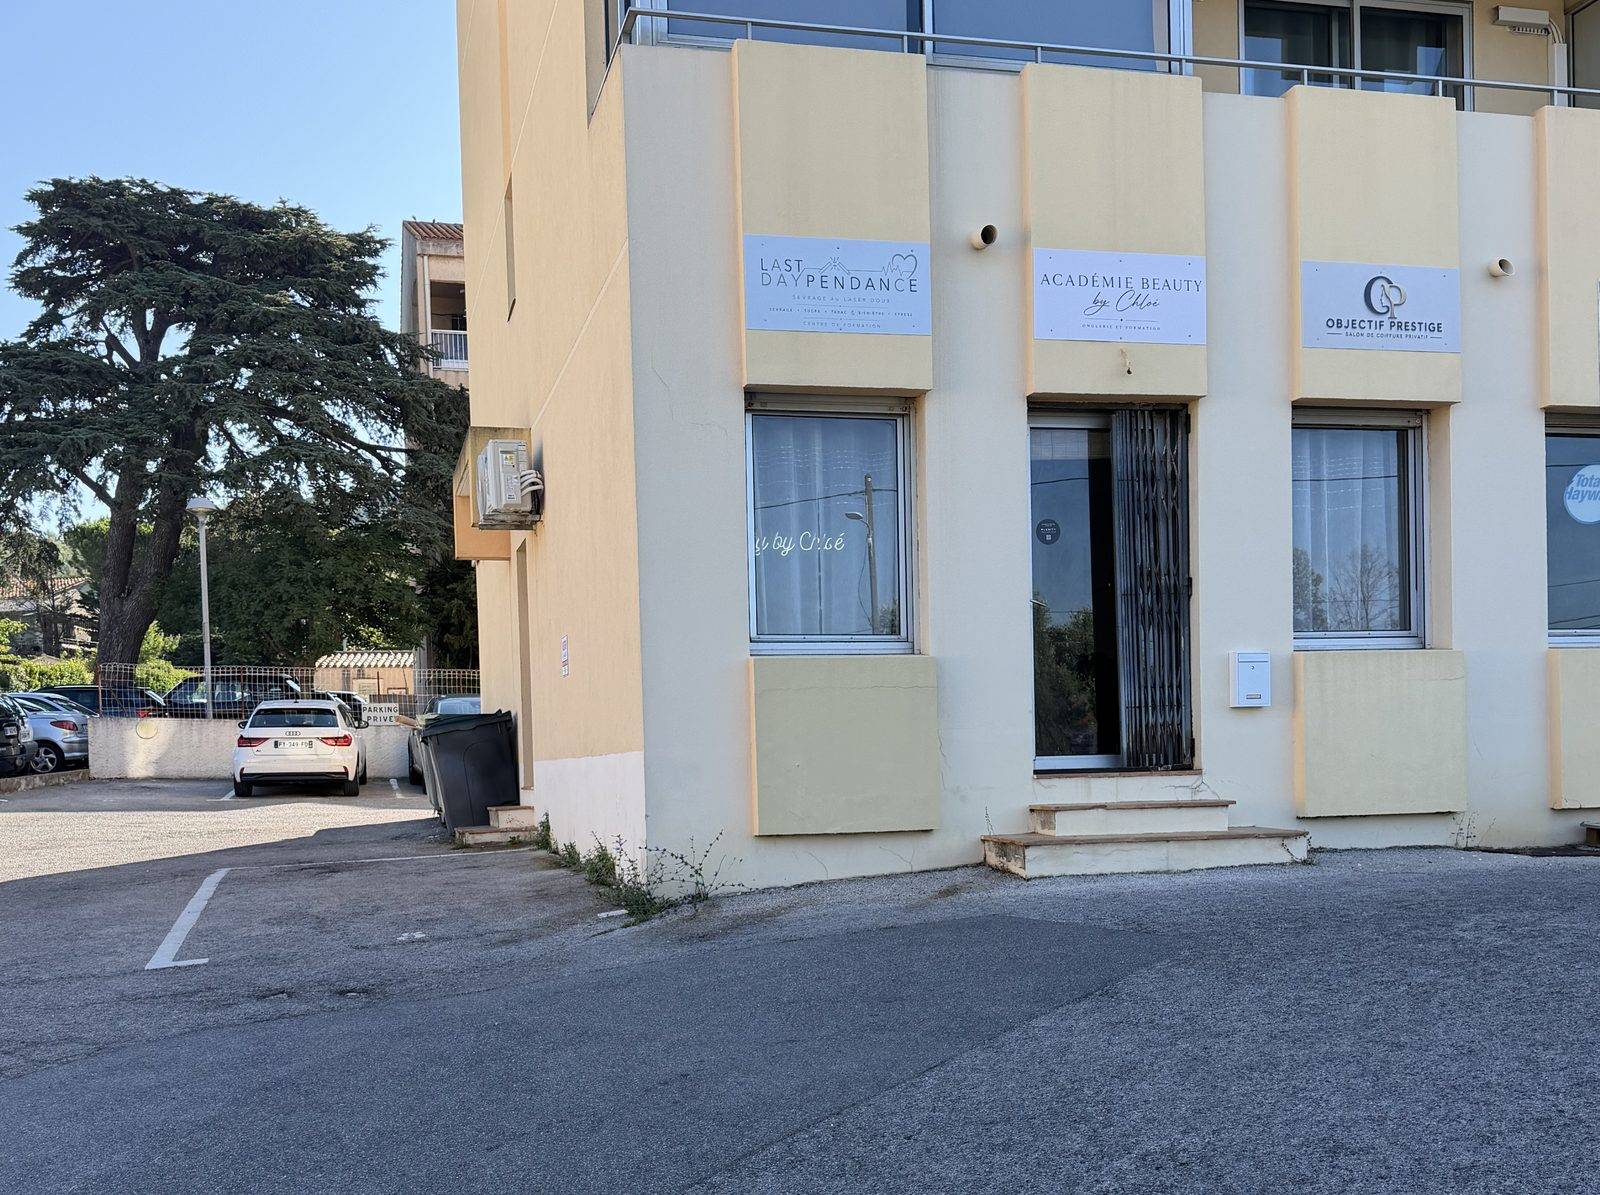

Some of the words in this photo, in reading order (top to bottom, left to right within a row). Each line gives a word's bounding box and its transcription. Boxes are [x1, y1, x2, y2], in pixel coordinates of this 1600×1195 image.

[760, 257, 803, 273] LAST
[1040, 272, 1134, 289] ACADÉMIE
[1141, 277, 1202, 292] BEAUTY
[1083, 291, 1110, 316] by
[1115, 289, 1160, 312] Chloé
[1325, 318, 1385, 330] OBJECTIF
[1389, 320, 1443, 333] PRESTIGE
[772, 531, 795, 556] by
